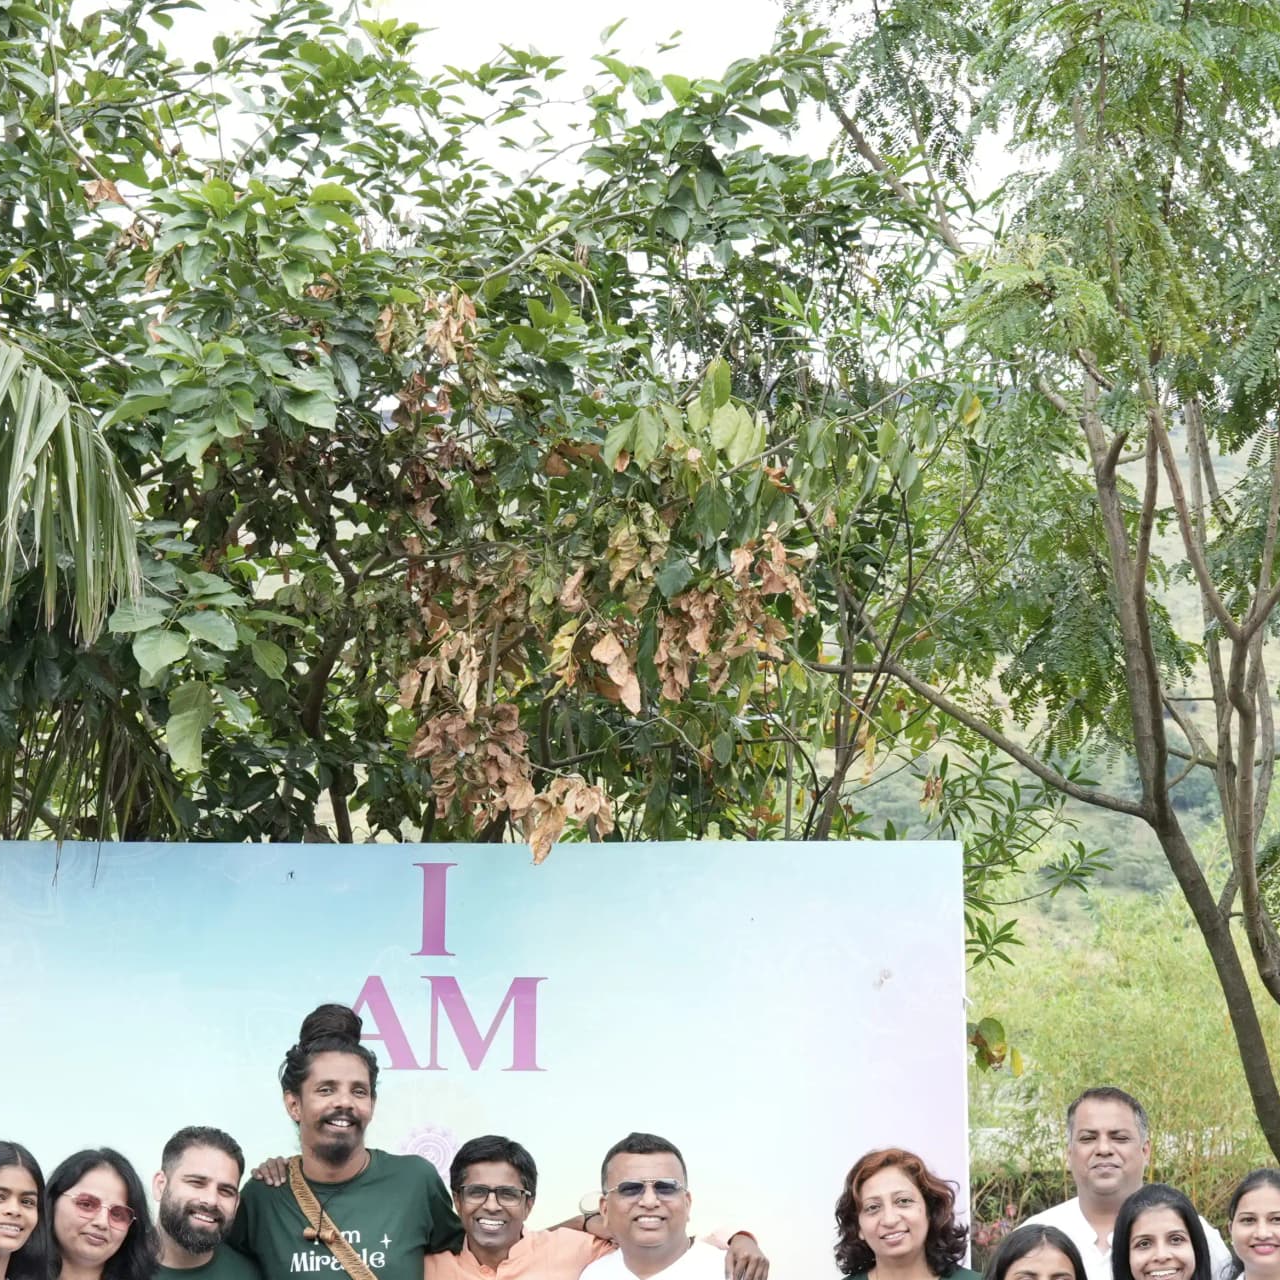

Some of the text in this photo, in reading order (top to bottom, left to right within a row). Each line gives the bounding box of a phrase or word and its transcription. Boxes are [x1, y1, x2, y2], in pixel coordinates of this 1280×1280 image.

[410, 862, 458, 956] I
[351, 975, 548, 1072] AM
[290, 1248, 386, 1272] Mirale
